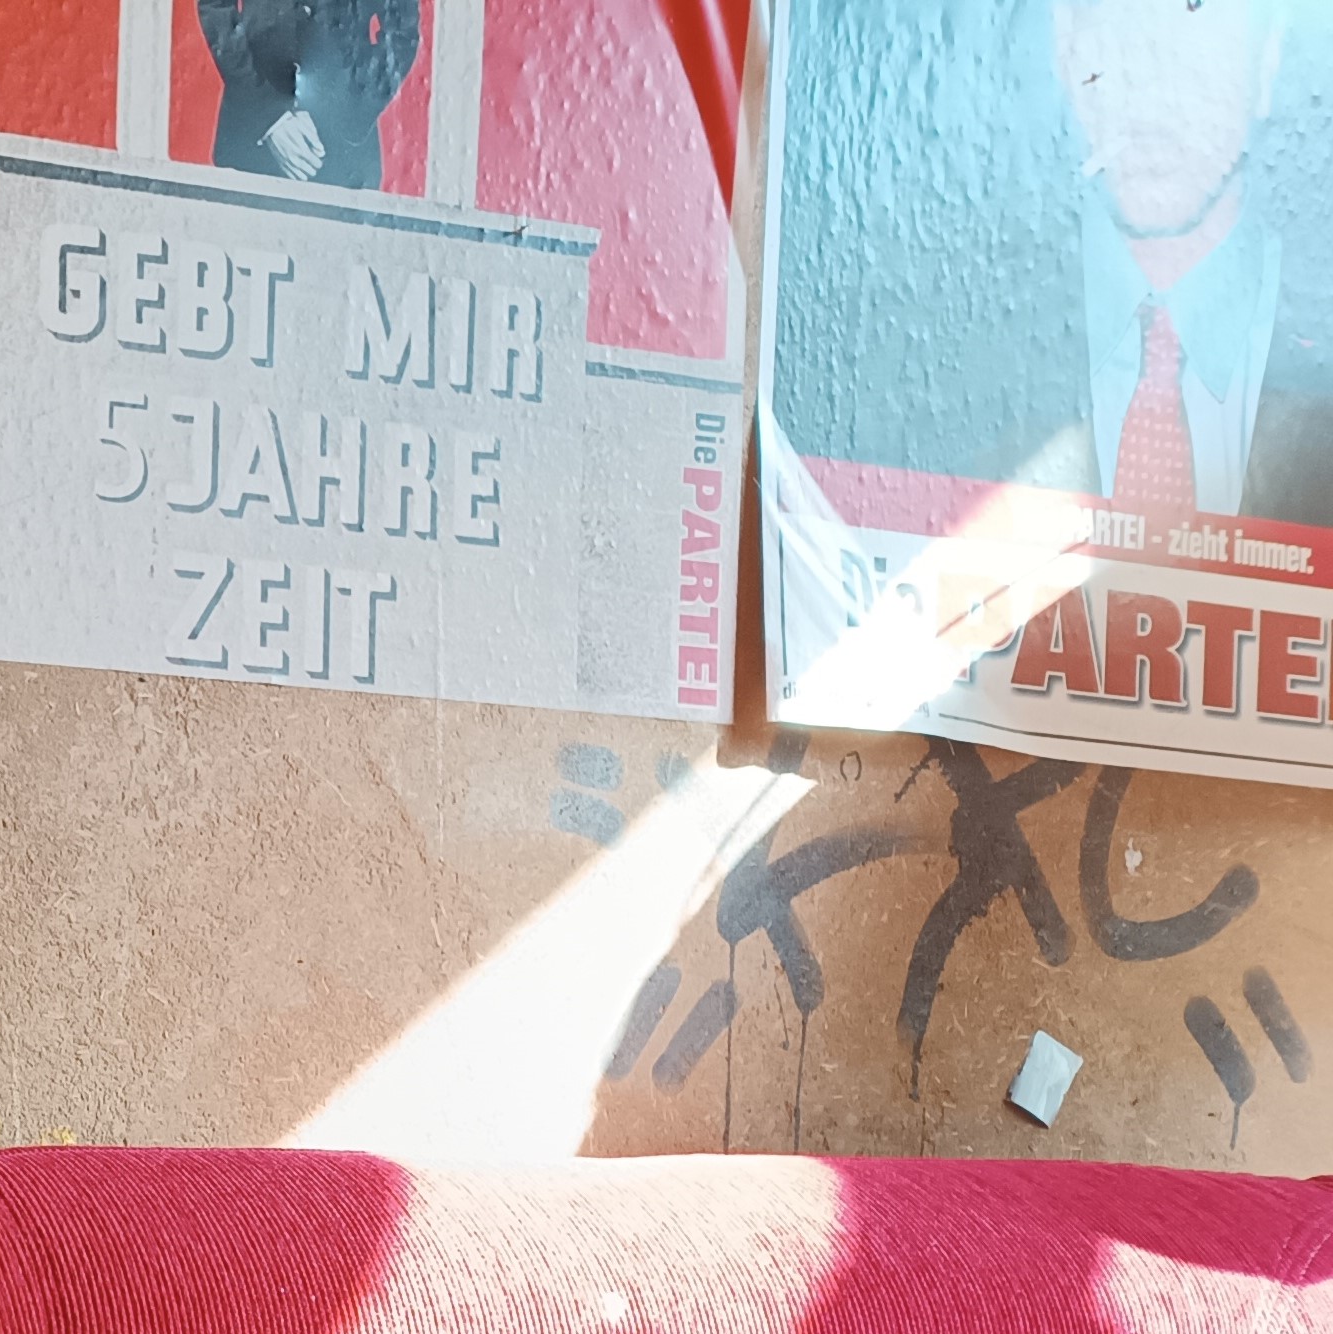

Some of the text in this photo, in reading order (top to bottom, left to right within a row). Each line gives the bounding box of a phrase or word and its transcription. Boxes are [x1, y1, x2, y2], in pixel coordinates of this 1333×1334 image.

[37, 222, 544, 402] GEBT MIR
[94, 395, 502, 548] 5 JAHRE
[1073, 508, 1146, 551] ARTEI
[1167, 521, 1229, 562] zieht
[1233, 528, 1315, 575] immer.
[163, 555, 397, 686] ZEIT
[677, 411, 726, 709] Die PARTEI
